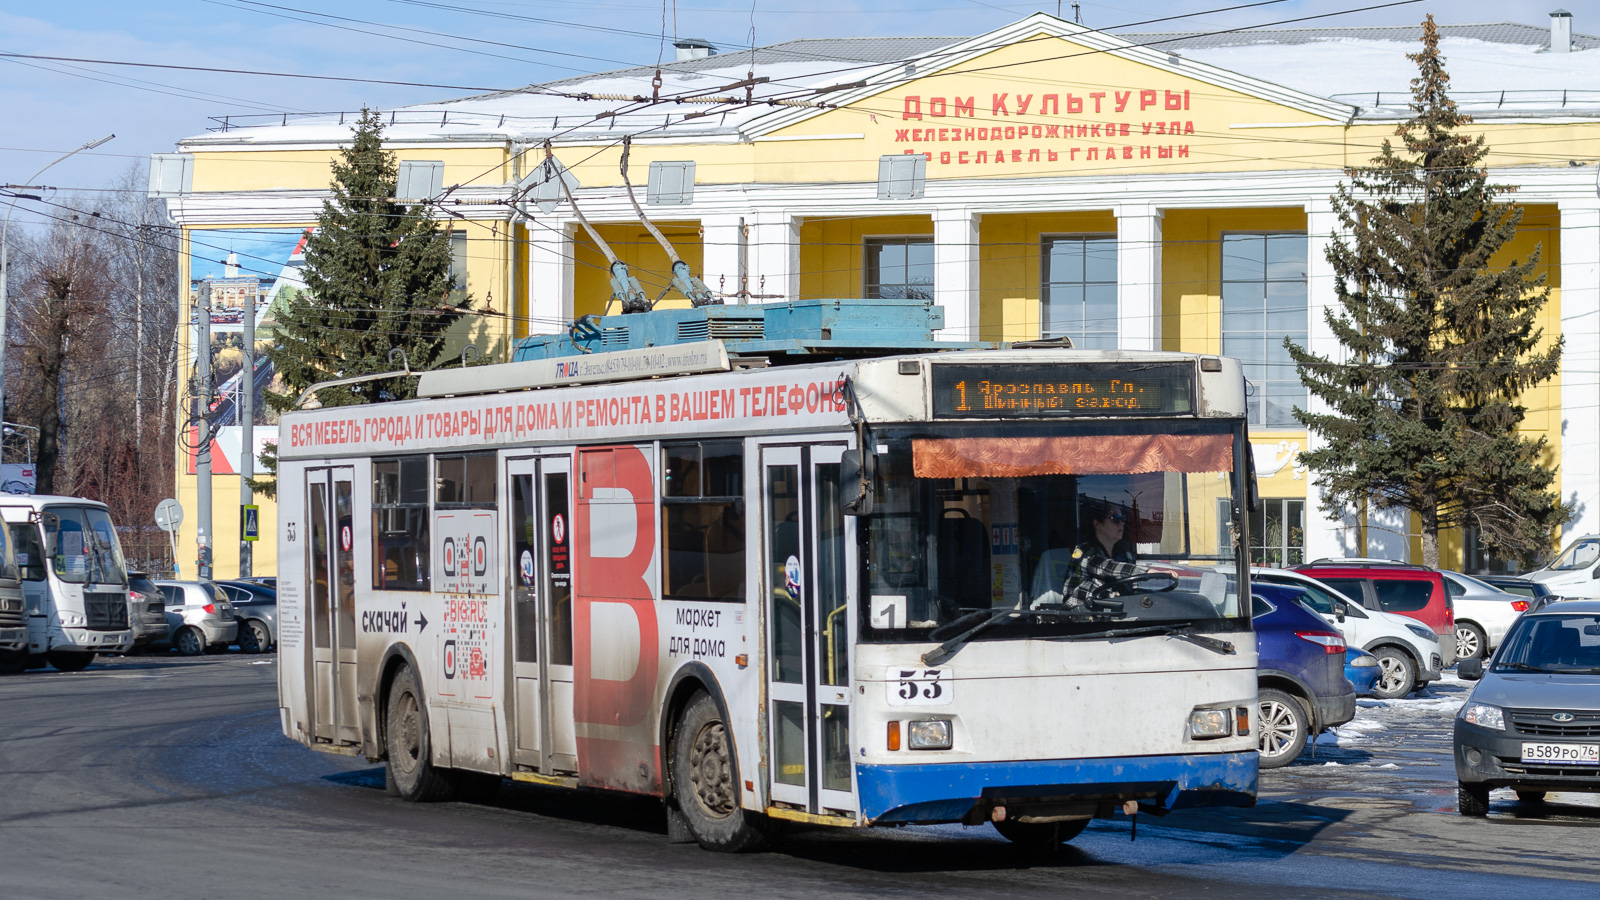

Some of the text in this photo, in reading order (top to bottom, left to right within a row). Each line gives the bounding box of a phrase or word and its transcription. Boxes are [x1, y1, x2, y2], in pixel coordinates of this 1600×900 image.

[902, 89, 1190, 121] ДОМ КУЛЬТУРЫ
[895, 120, 1195, 142] ЖЕЛЕЗНОДОРОЖНИКОВ УЗЛА
[555, 361, 579, 378] TROLZA
[955, 380, 970, 411] 1
[978, 380, 1095, 397] Ярославль
[291, 380, 846, 448] ВСЯ МЕБЕЛЬ ГОРОДА И ТОВАРЫ ДЛЯ ДОМА И РЕМОНТА В ВАШЕМ ТЕЛЕФОНЕ
[362, 602, 407, 633] скачай
[450, 600, 485, 622] BIG.RU
[676, 606, 721, 633] маркет
[880, 604, 896, 628] 1
[669, 636, 726, 659] для дома
[899, 670, 942, 699] 53
